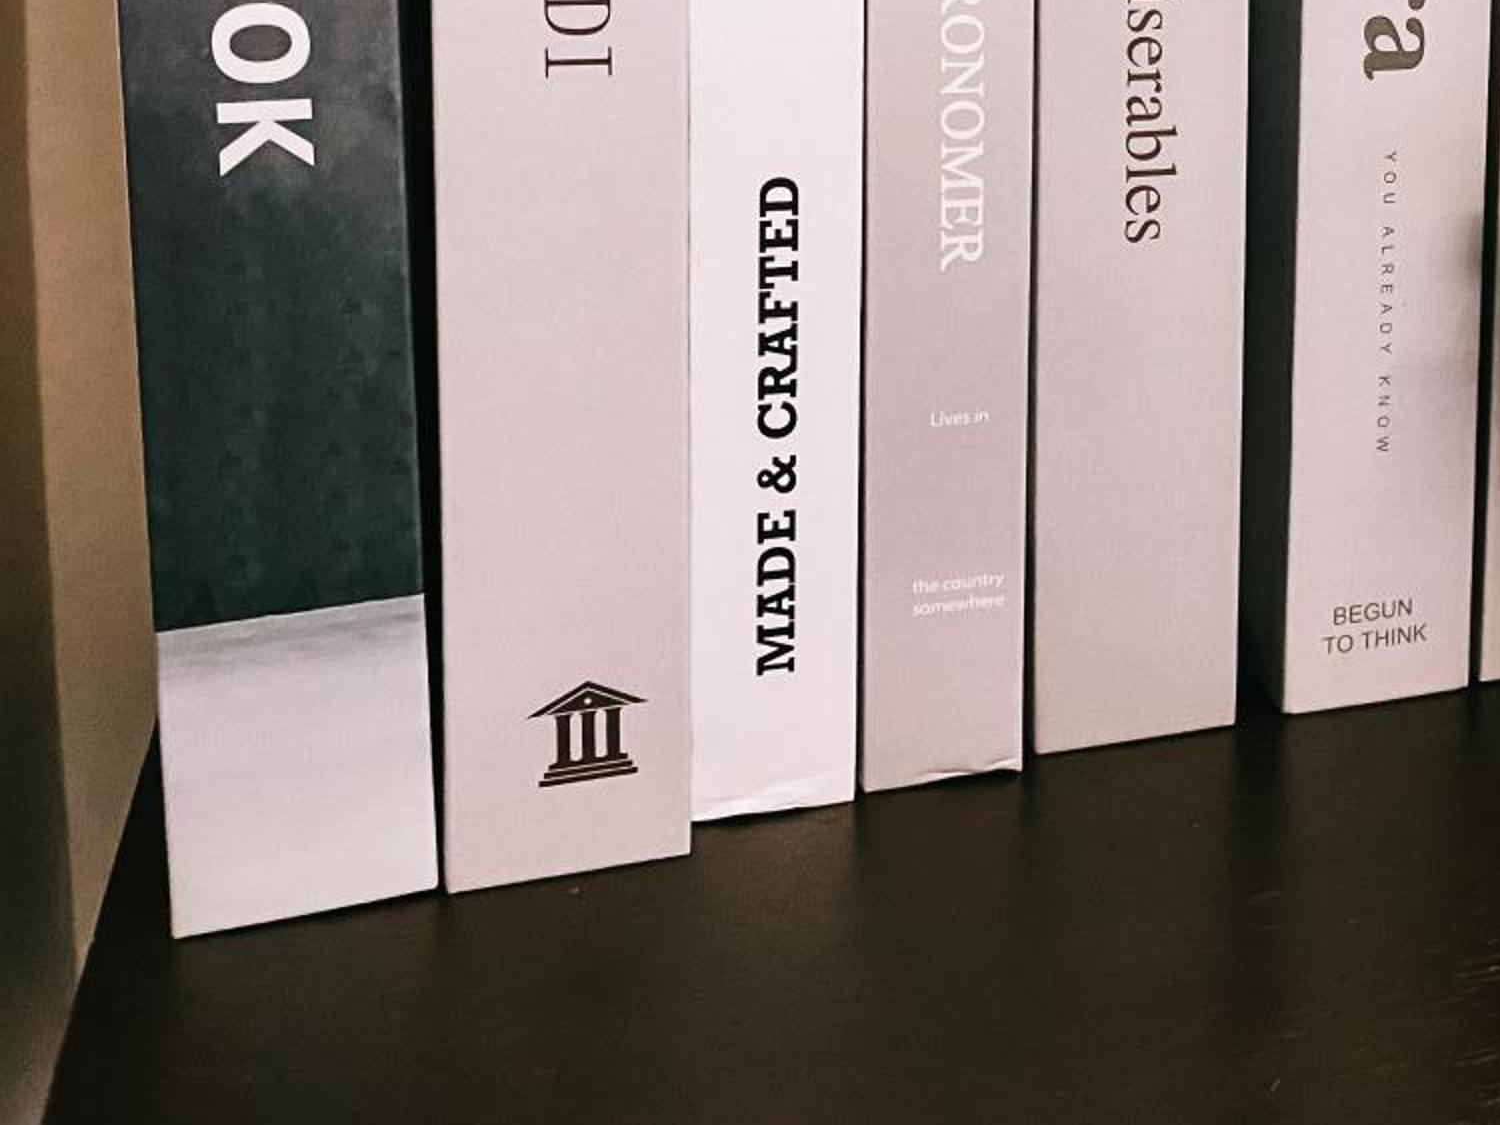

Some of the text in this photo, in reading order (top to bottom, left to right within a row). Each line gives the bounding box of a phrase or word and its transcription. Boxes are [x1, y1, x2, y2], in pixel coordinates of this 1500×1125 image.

[1375, 150, 1399, 454] YOU ALREADY KNOW
[757, 177, 800, 677] MADE & CRAFTED
[930, 410, 990, 428] Lives in
[912, 573, 1005, 595] the country
[912, 595, 1006, 618] somewhere
[1332, 597, 1413, 626] BEGUN
[1321, 622, 1427, 655] TO THINK
